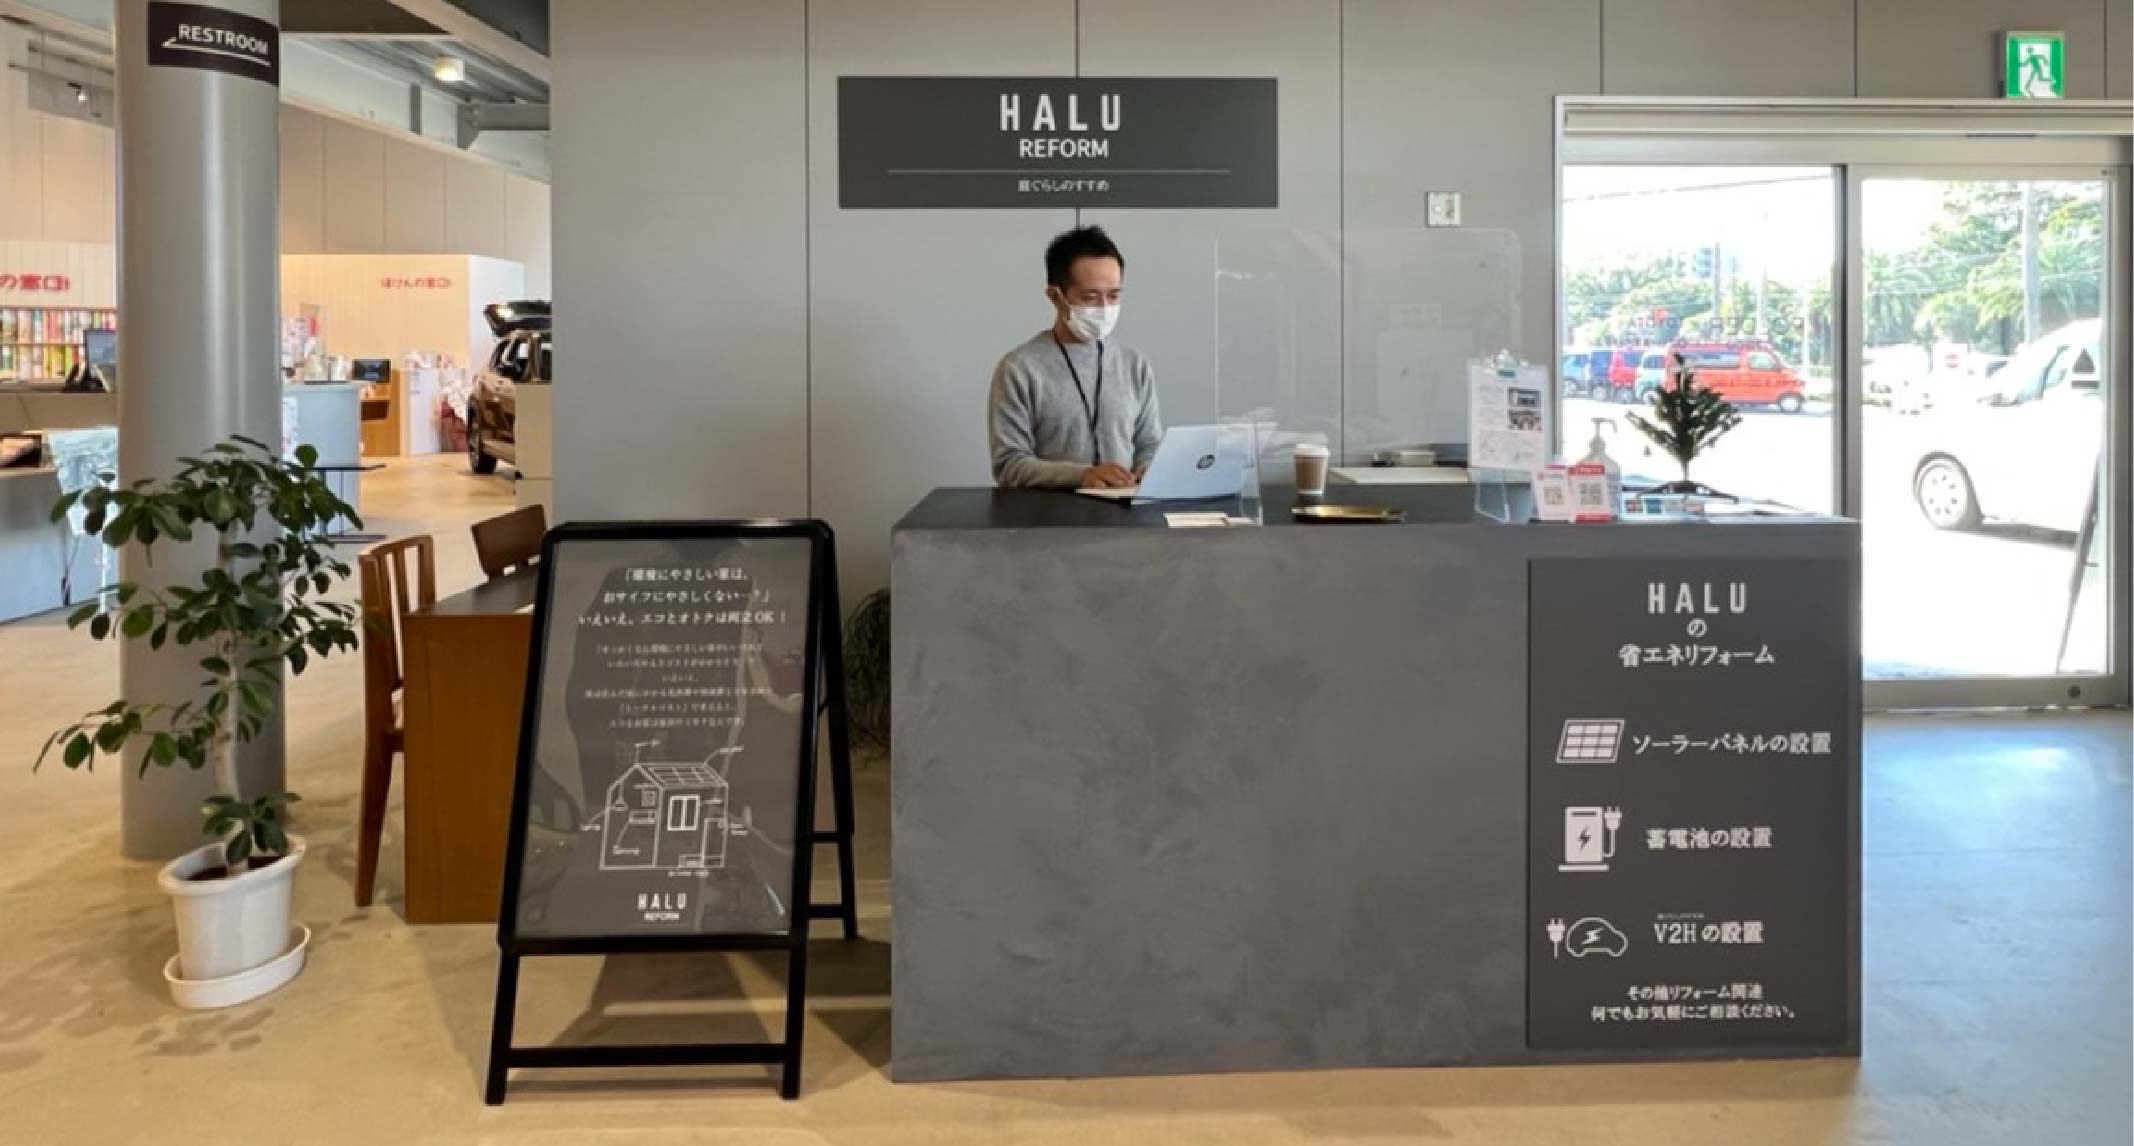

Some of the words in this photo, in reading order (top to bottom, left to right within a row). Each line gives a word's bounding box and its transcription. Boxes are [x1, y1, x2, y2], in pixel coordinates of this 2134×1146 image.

[178, 24, 268, 55] RESTROOM
[1000, 94, 1121, 132] HALU
[1020, 138, 1108, 158] REFORM
[1647, 583, 1747, 614] HALU
[1686, 617, 1708, 638] の
[1618, 644, 1775, 668] 省エネリフォーム
[1646, 827, 1772, 849] 蓄電池の設置
[637, 892, 687, 910] HALU
